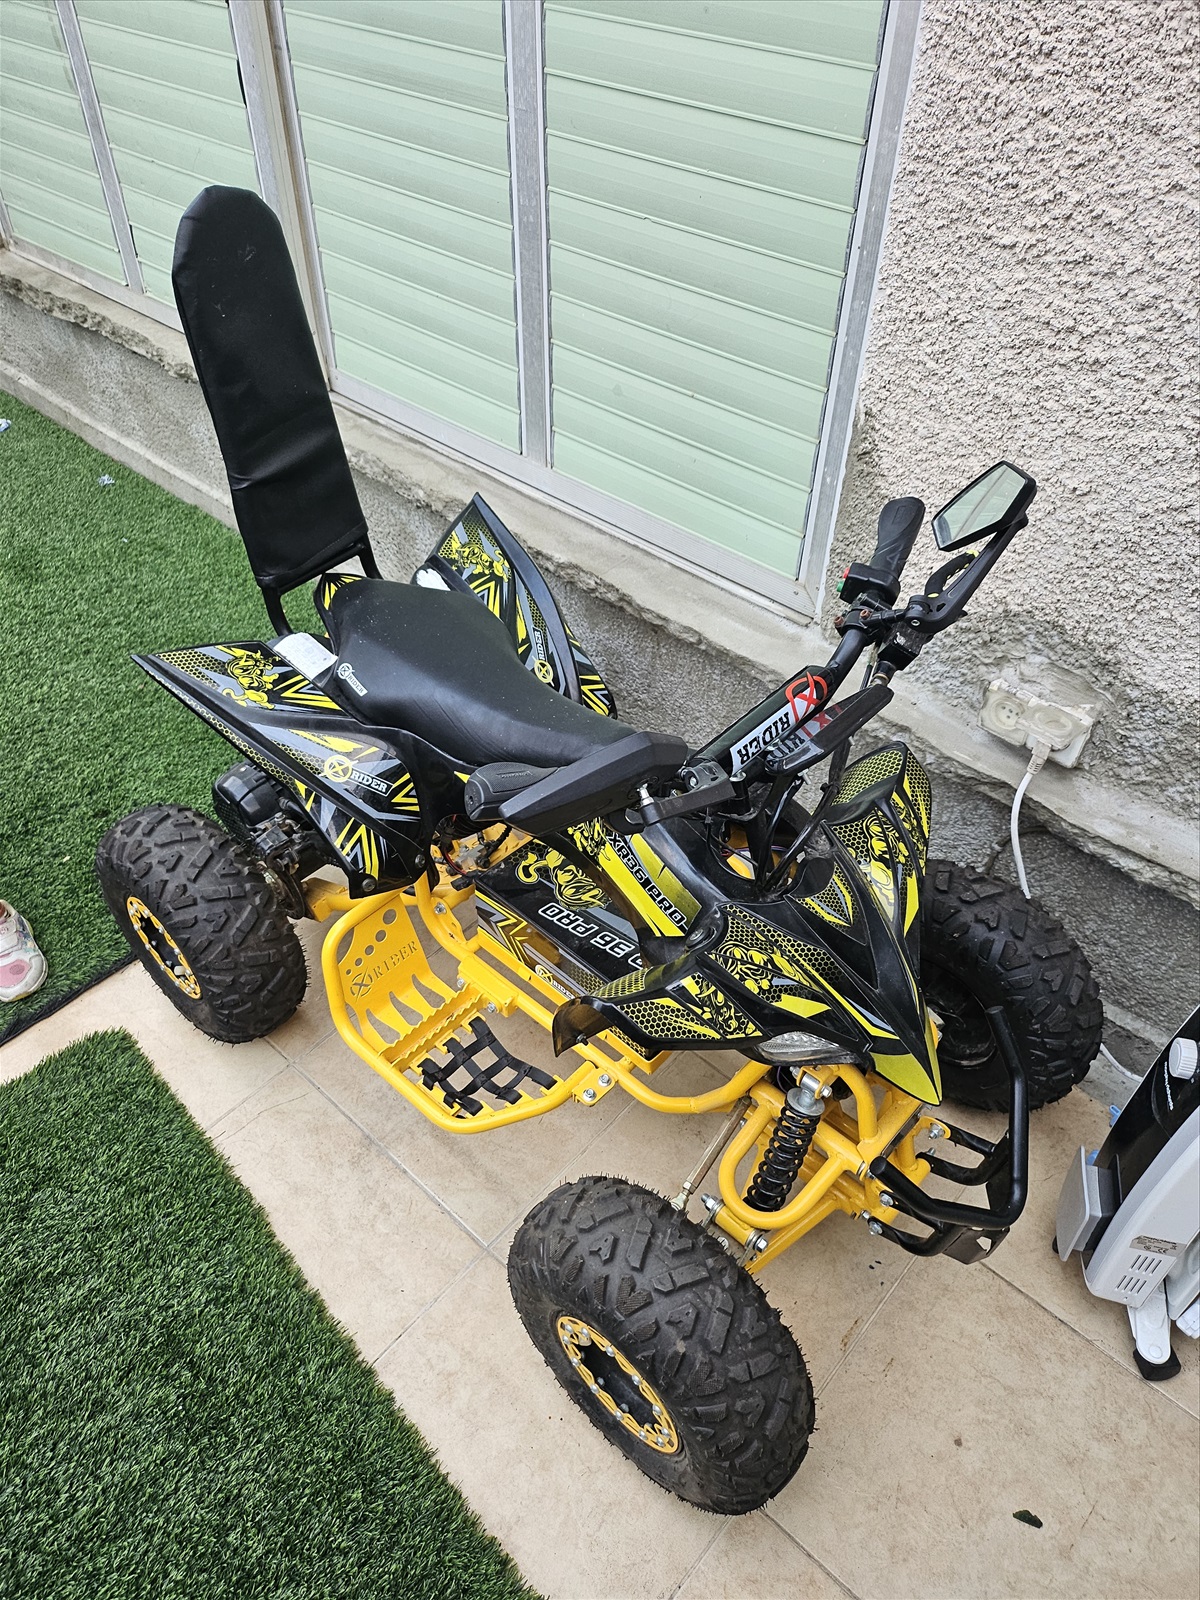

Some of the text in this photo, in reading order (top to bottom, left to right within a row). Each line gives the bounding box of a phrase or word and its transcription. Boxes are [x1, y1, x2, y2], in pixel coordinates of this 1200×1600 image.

[534, 630, 546, 661] RIDER
[347, 672, 365, 694] RIDER
[736, 711, 791, 766] RIDER
[350, 769, 388, 794] RIDER
[606, 831, 688, 927] XR36 PRO
[537, 902, 599, 938] PRO
[372, 940, 418, 979] RIDER
